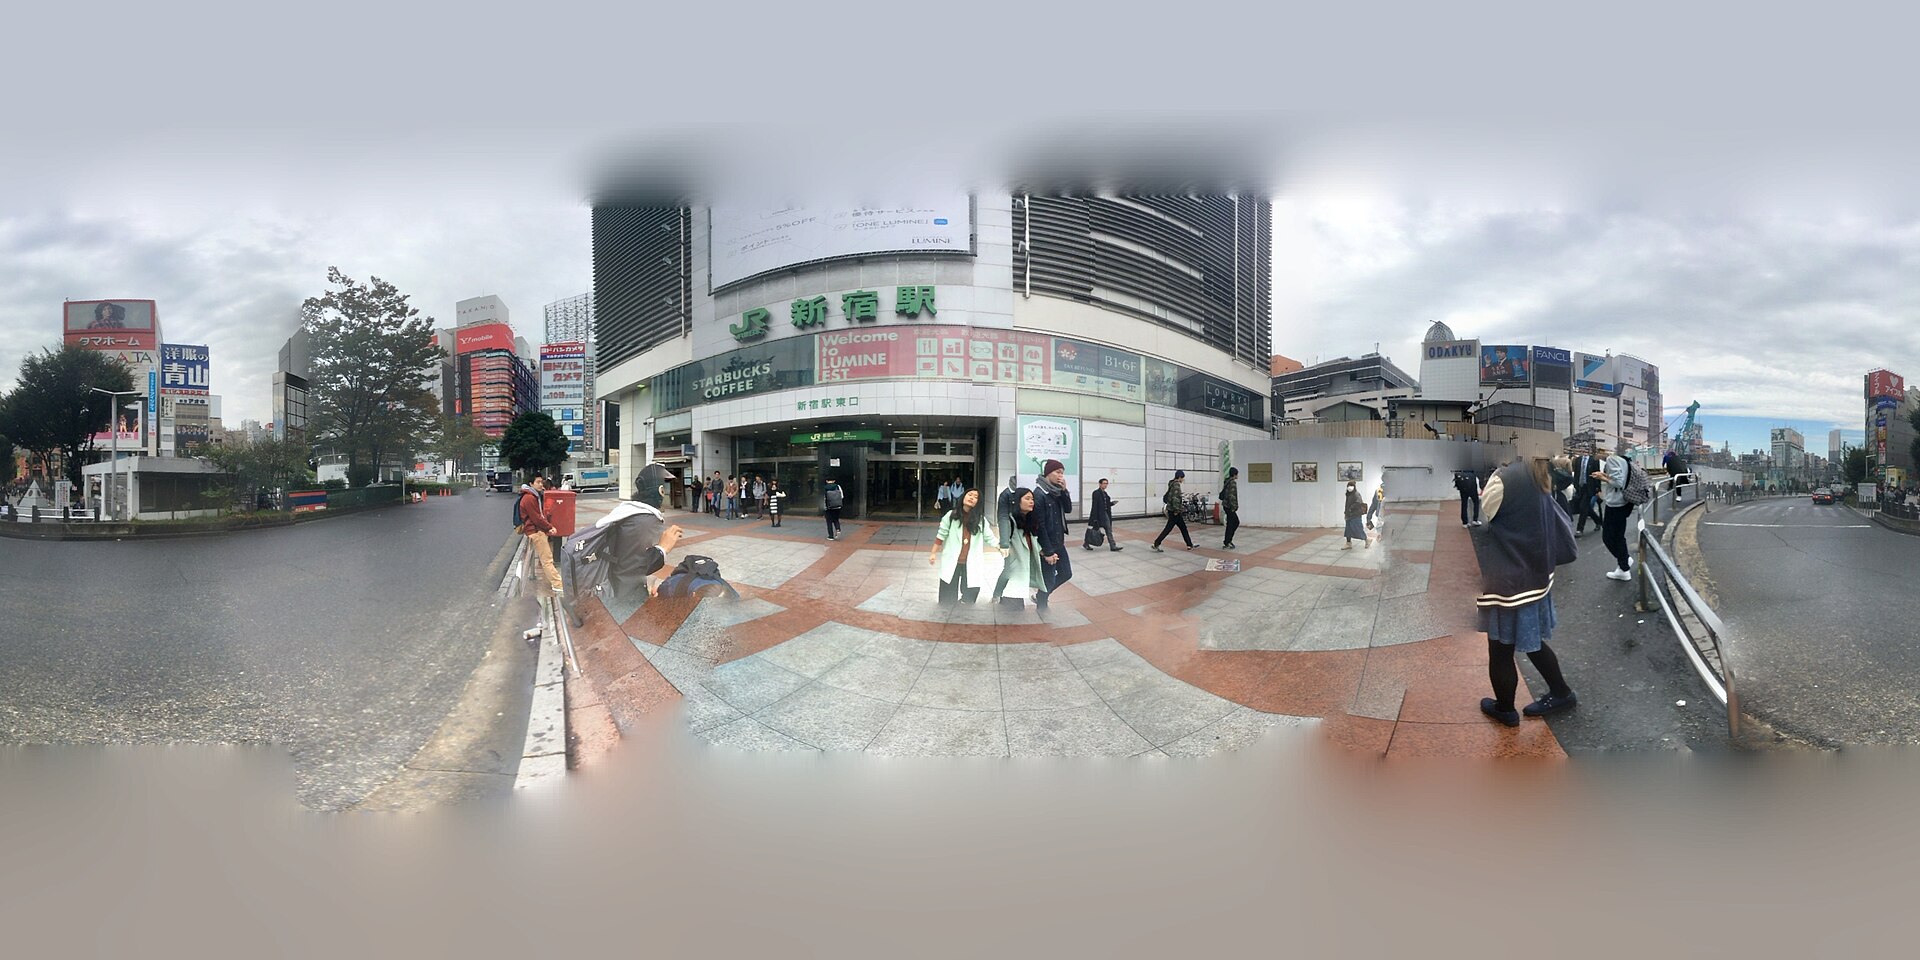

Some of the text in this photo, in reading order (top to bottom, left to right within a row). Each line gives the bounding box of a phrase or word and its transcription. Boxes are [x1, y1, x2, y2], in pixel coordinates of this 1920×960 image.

[457, 304, 495, 315] TAKANO
[729, 285, 938, 337] JR 新宿駅
[78, 336, 140, 347] タマホーム
[459, 334, 493, 345] Y!mobile
[822, 332, 899, 347] Welcome
[164, 347, 209, 362] 洋服の
[541, 345, 584, 353] ヨドバシカメラ
[822, 347, 838, 357] to
[1428, 344, 1473, 359] ODAKYU
[1536, 350, 1568, 362] FANCL
[543, 361, 583, 371] ヨドバシ
[822, 352, 887, 370] LUMINE
[162, 362, 209, 386] 青山
[552, 371, 583, 382] カメラ
[692, 363, 771, 391] STARBUCKS
[822, 368, 850, 382] EST
[704, 379, 754, 399] COFFEE
[1207, 385, 1248, 406] LOWRYS
[797, 397, 859, 411] 新宿駅東口
[1211, 398, 1245, 415] FARM
